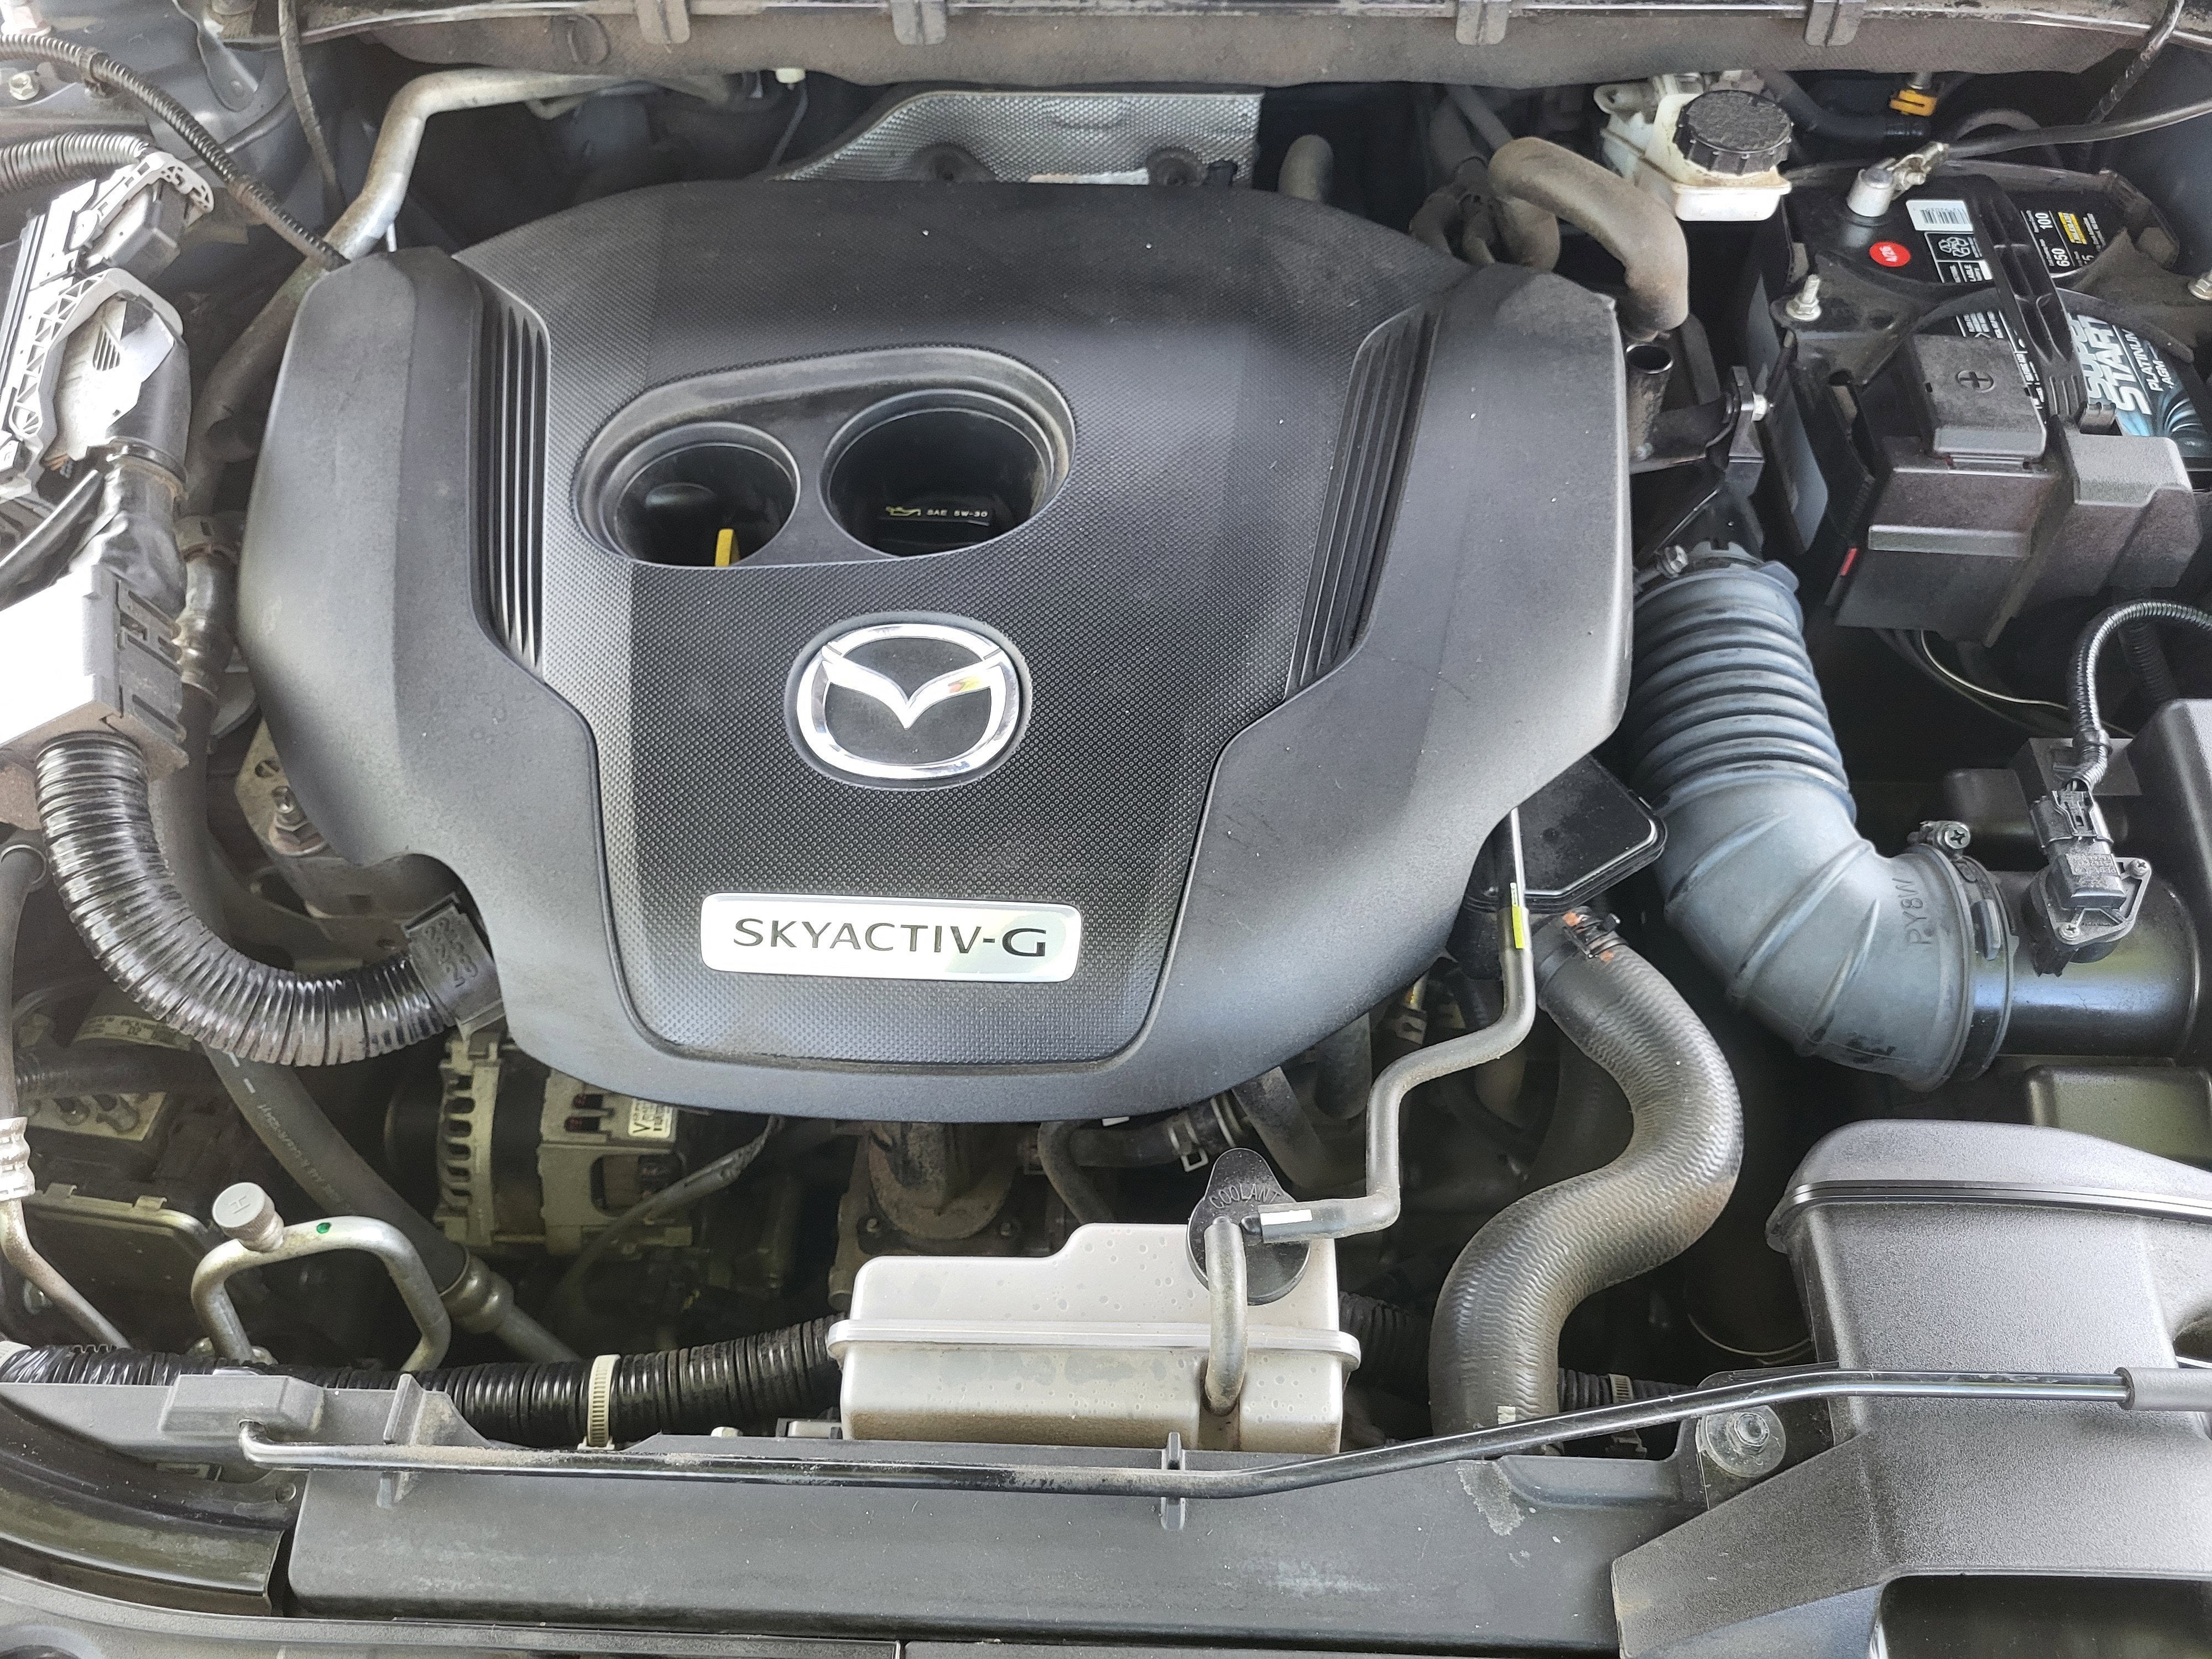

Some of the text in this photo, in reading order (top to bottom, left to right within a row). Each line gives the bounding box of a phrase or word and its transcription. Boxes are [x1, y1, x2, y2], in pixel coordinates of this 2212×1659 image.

[2035, 213, 2053, 229] 100
[2052, 248, 2070, 267] 650
[2077, 315, 2153, 415] START
[1892, 878, 1932, 945] PY8W
[733, 918, 1046, 957] SKYACTIV-G
[1209, 1182, 1282, 1209] COOLANT
